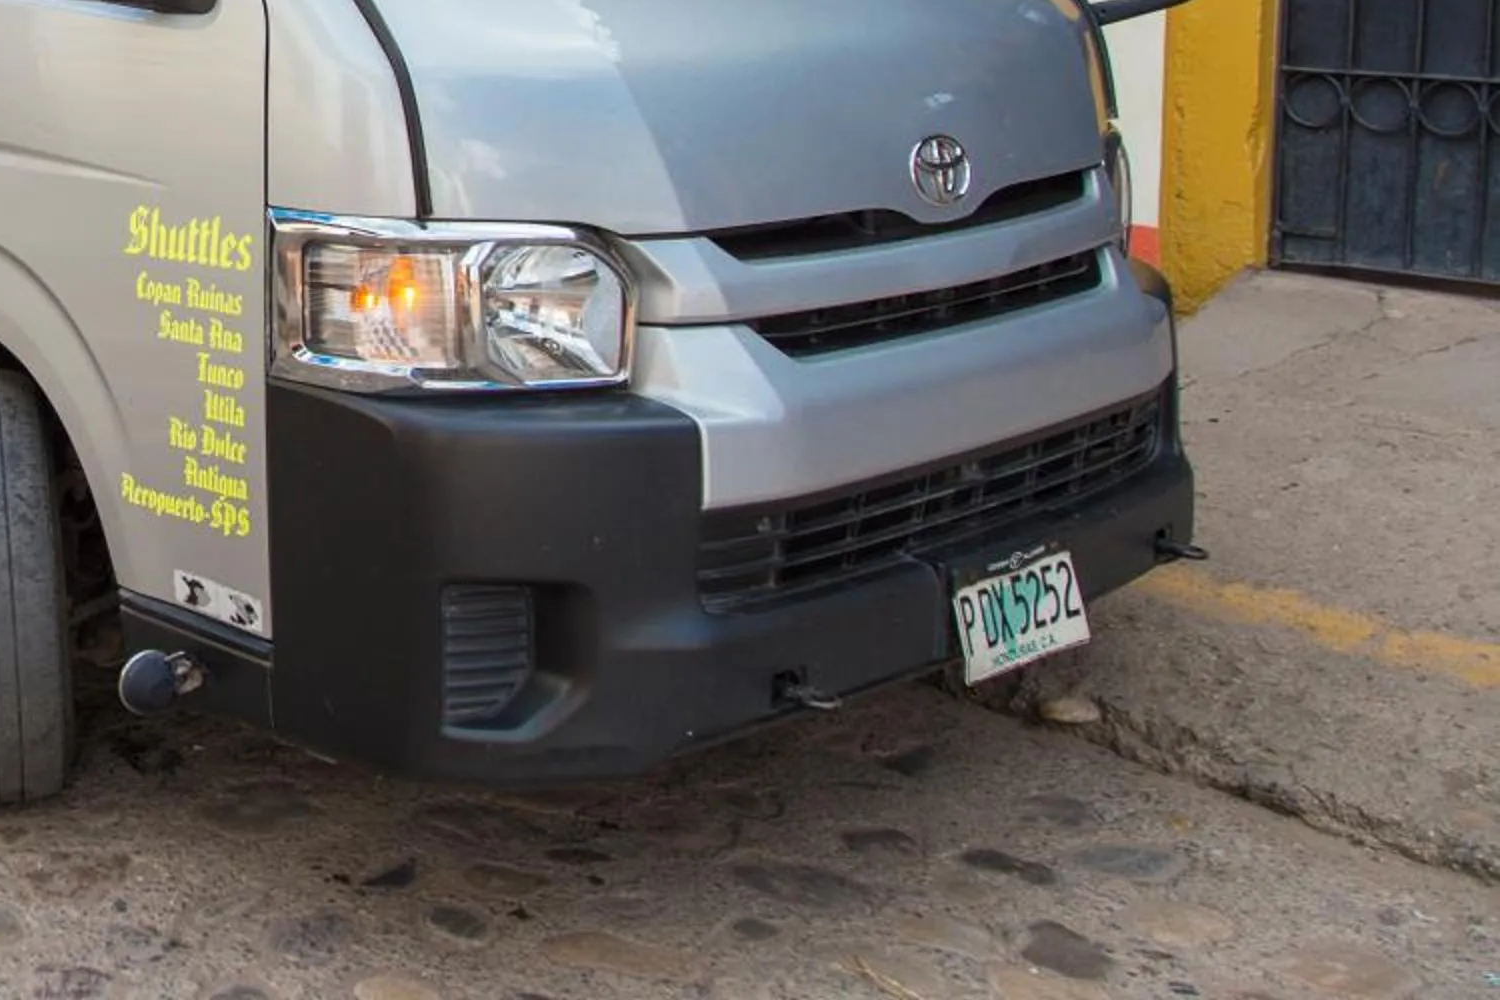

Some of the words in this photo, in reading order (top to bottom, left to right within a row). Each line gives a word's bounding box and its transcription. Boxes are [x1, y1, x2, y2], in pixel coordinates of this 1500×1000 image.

[124, 205, 252, 271] Shuttles
[136, 271, 181, 305] Copan
[186, 278, 242, 315] Ruinas
[158, 309, 204, 344] Santa
[209, 318, 243, 353] Ana
[197, 352, 244, 388] Tunco
[169, 417, 197, 450] Rio
[201, 425, 246, 463] Dulce
[184, 456, 248, 500] Antigua
